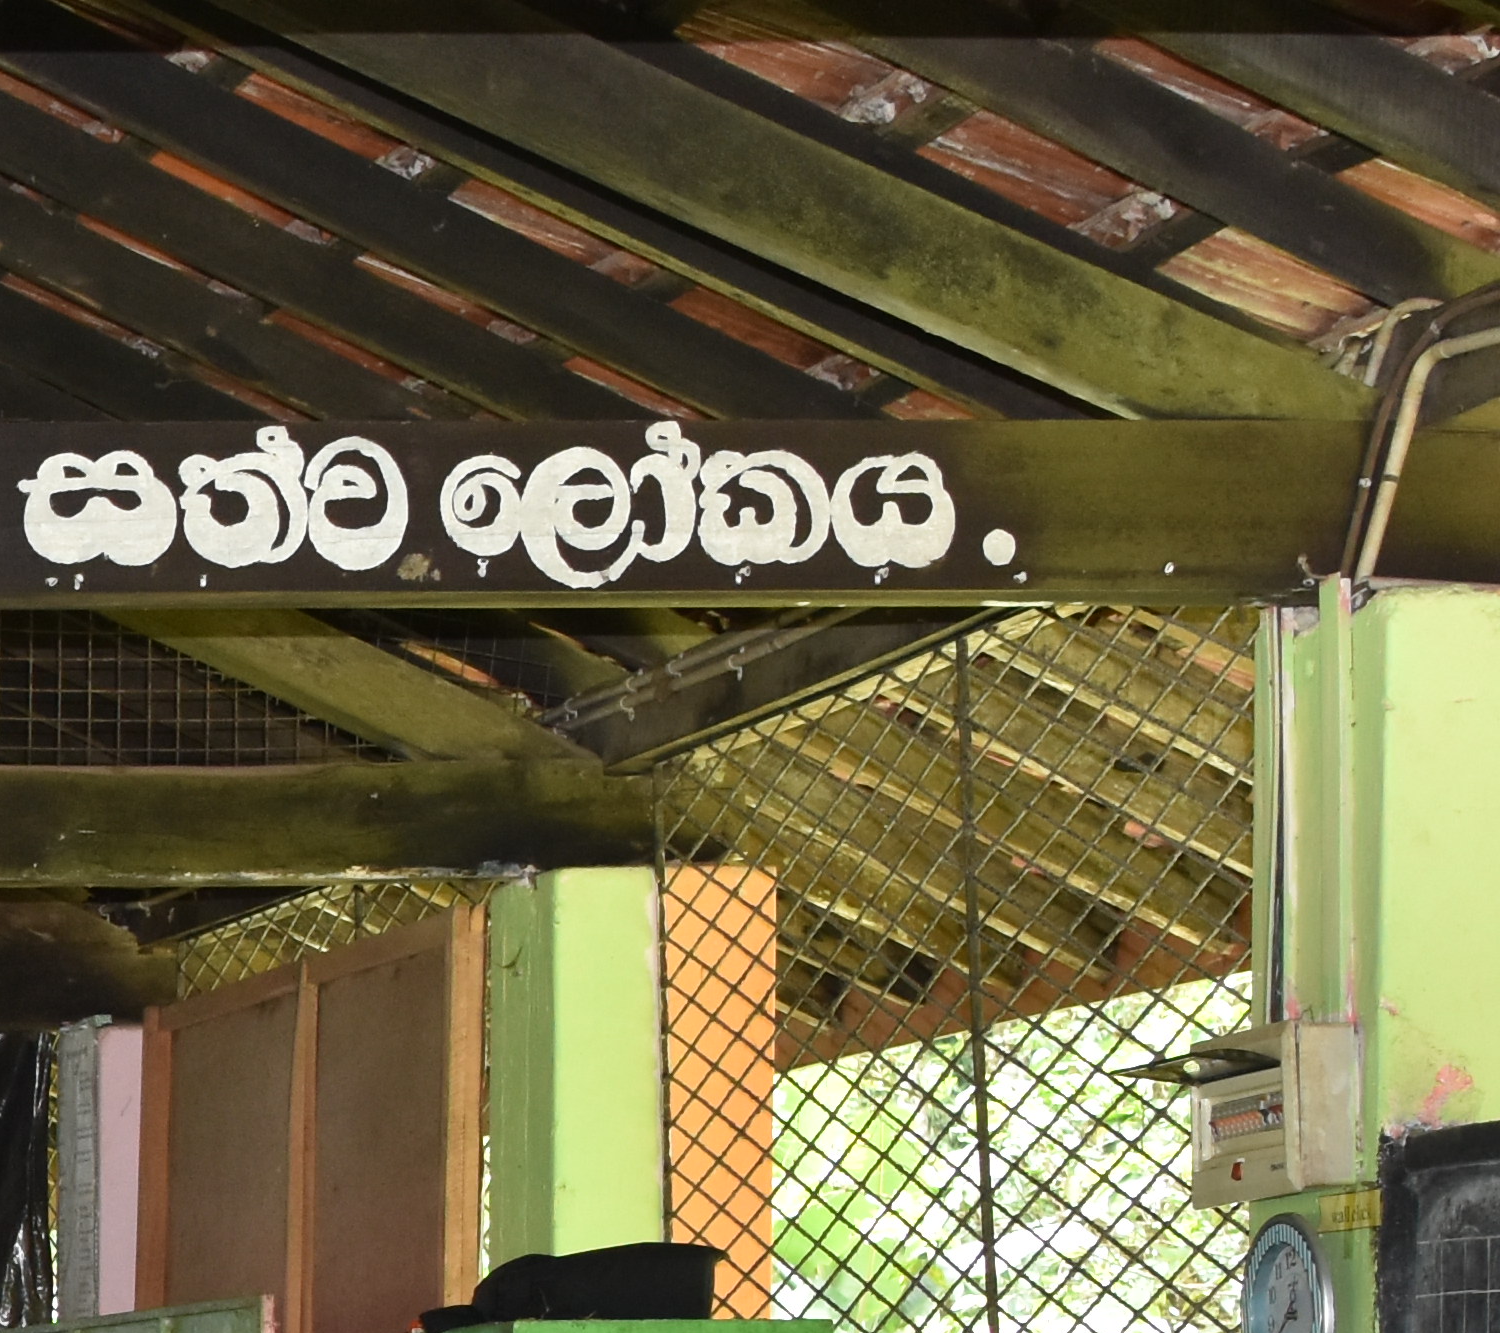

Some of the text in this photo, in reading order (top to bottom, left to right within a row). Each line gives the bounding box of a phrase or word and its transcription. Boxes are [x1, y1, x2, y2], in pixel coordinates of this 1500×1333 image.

[17, 424, 409, 573] සත්ව
[1284, 1249, 1297, 1271] 12
[1267, 1314, 1275, 1333] 9
